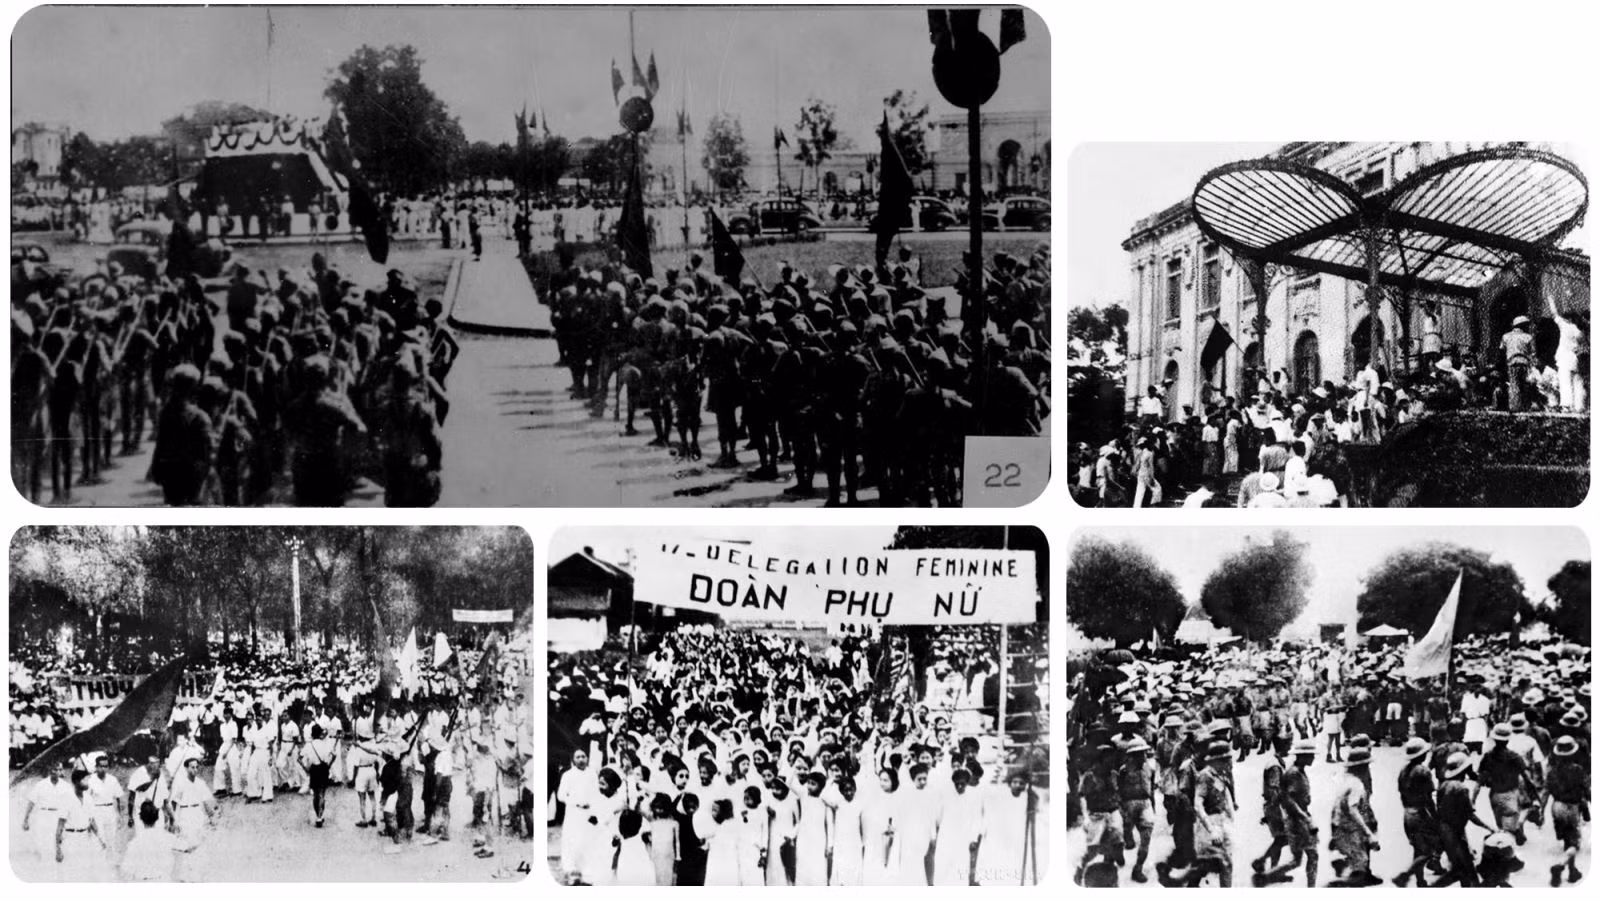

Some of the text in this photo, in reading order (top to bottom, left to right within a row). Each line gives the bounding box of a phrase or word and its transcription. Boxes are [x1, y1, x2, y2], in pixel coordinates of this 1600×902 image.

[984, 463, 1022, 488] 22
[915, 557, 1018, 577] FEMININE
[689, 573, 788, 611] DOÀN
[824, 589, 894, 623] PHỤ
[516, 860, 532, 875] 4
